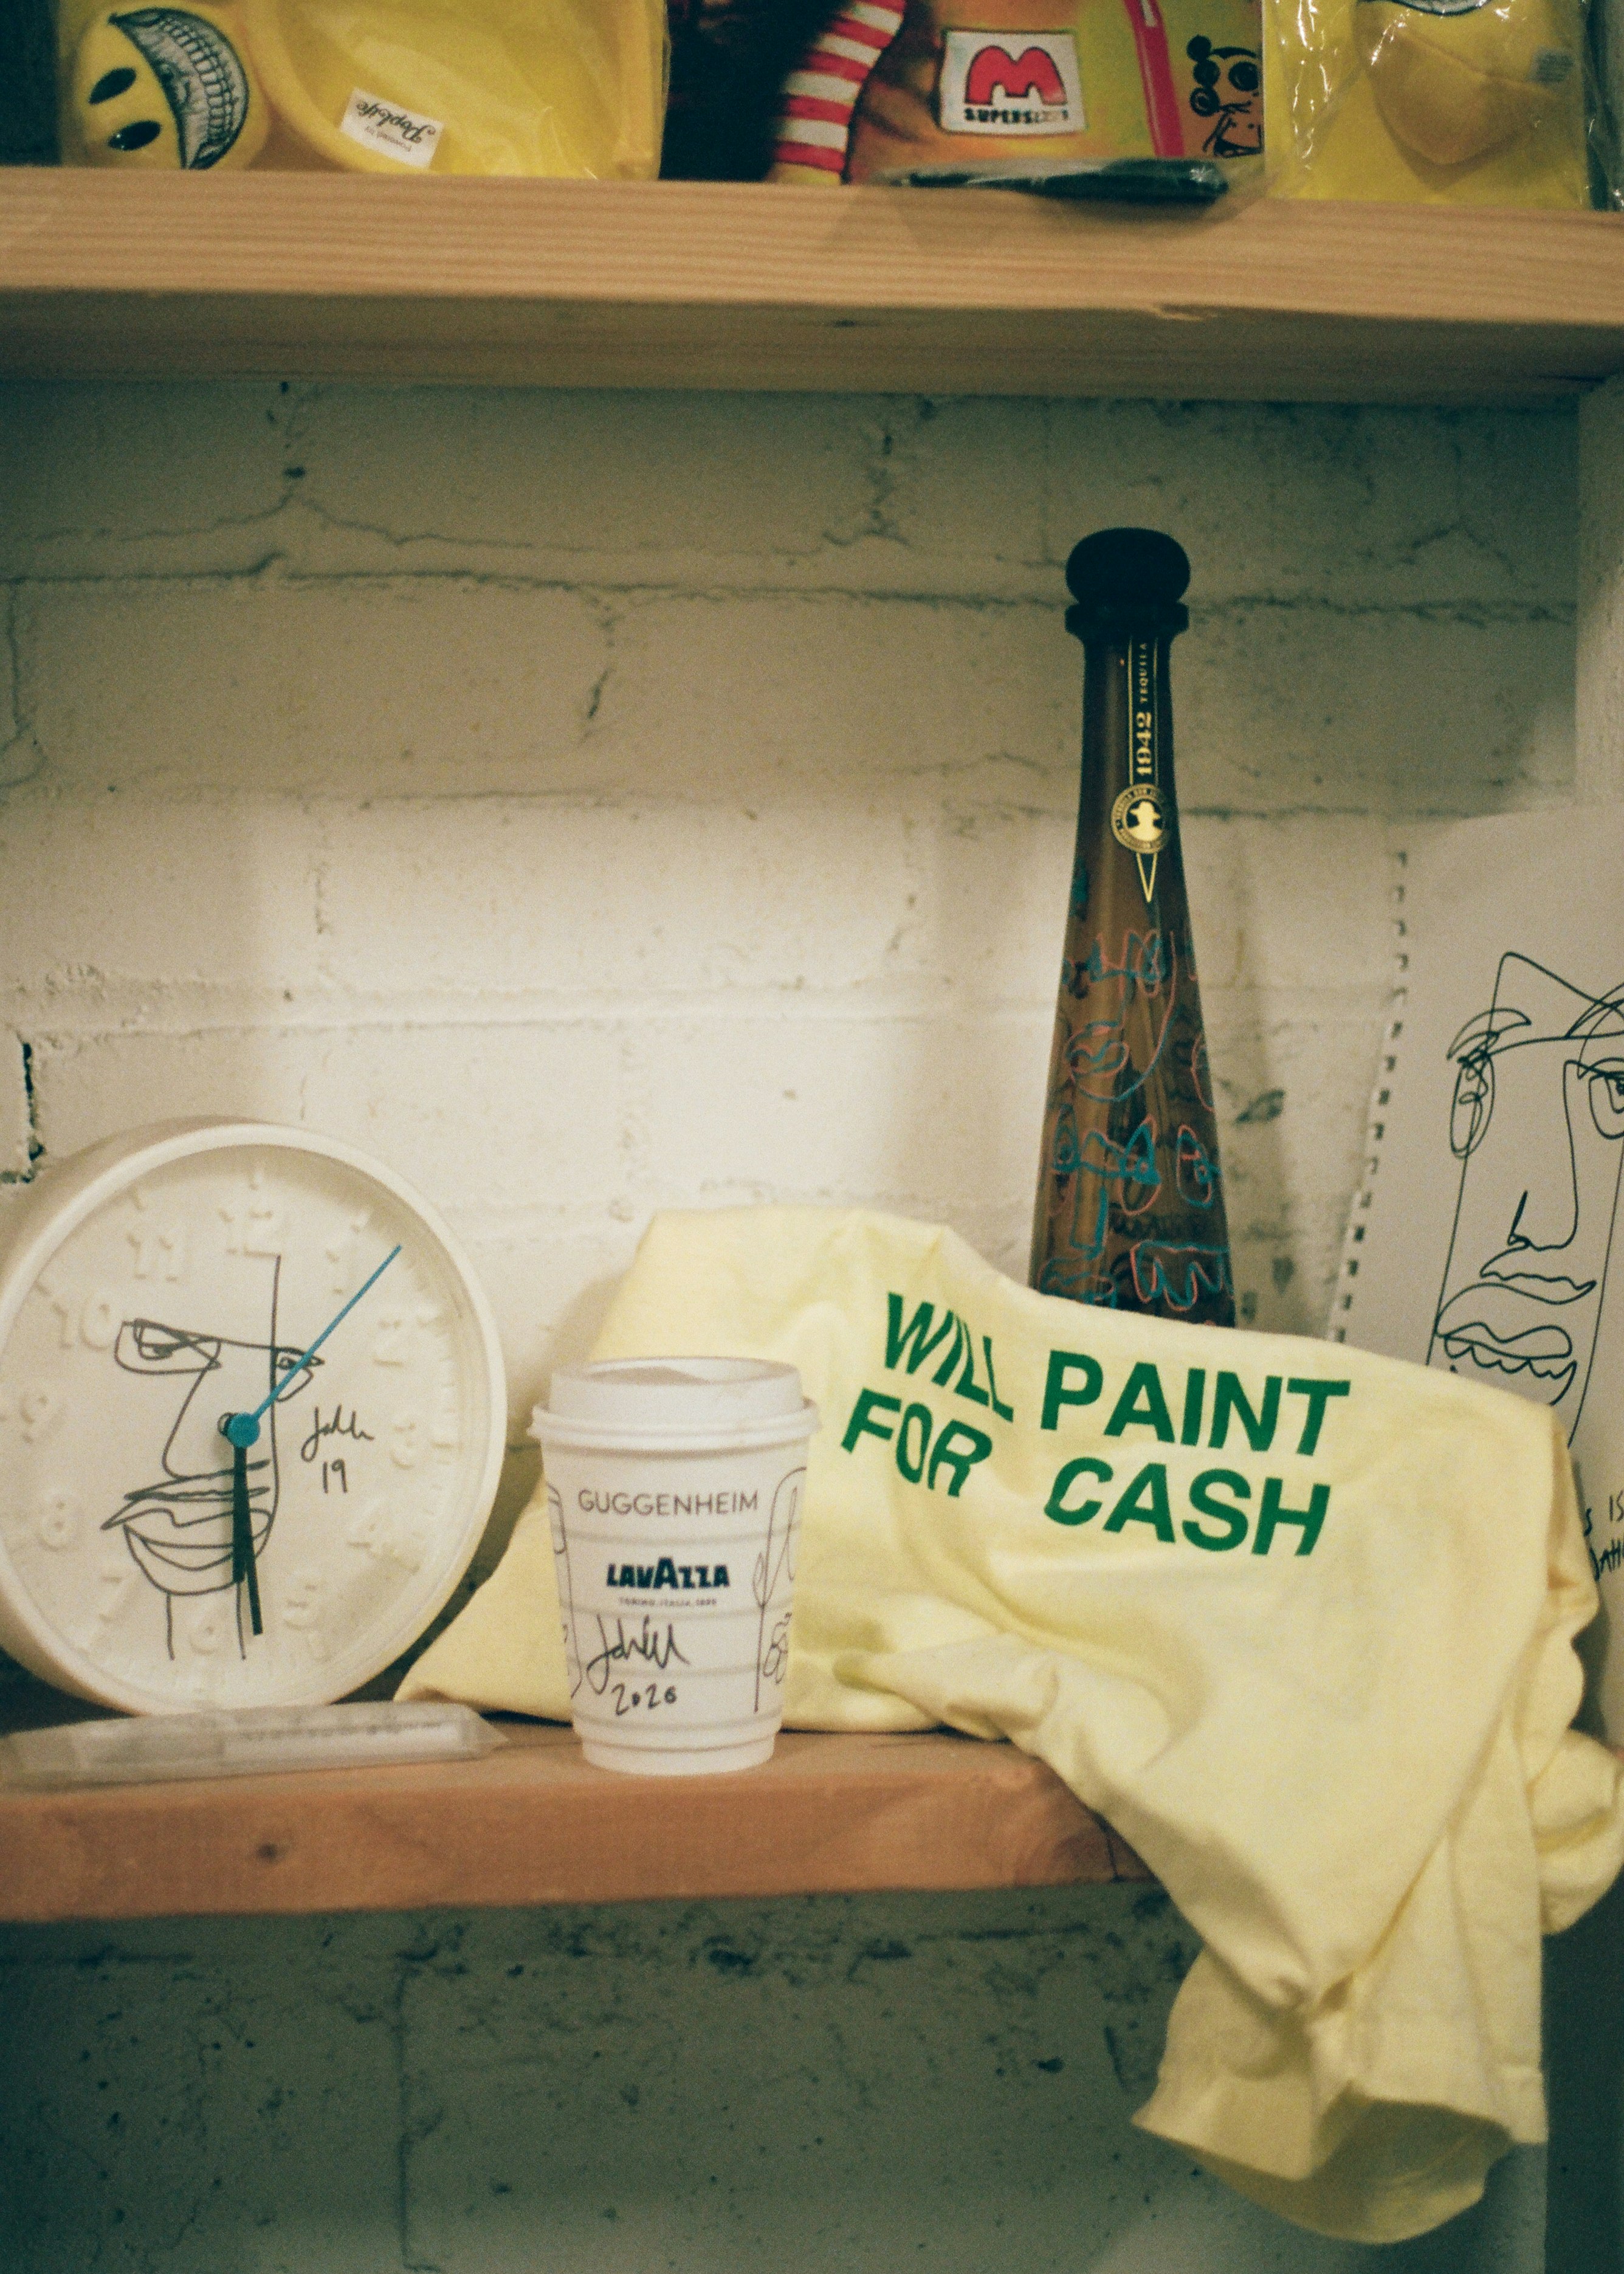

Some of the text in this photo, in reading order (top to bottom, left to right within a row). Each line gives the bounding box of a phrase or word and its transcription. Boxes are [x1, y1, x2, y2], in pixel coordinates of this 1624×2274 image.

[1135, 642, 1153, 776] 1942 TEQUILA
[884, 1291, 1352, 1456] WILL PAINT
[322, 1458, 348, 1494] 19
[577, 1489, 759, 1516] GUGGENHEIM
[840, 1387, 1332, 1557] FOR CASH
[607, 1556, 731, 1590] LAVAZZA
